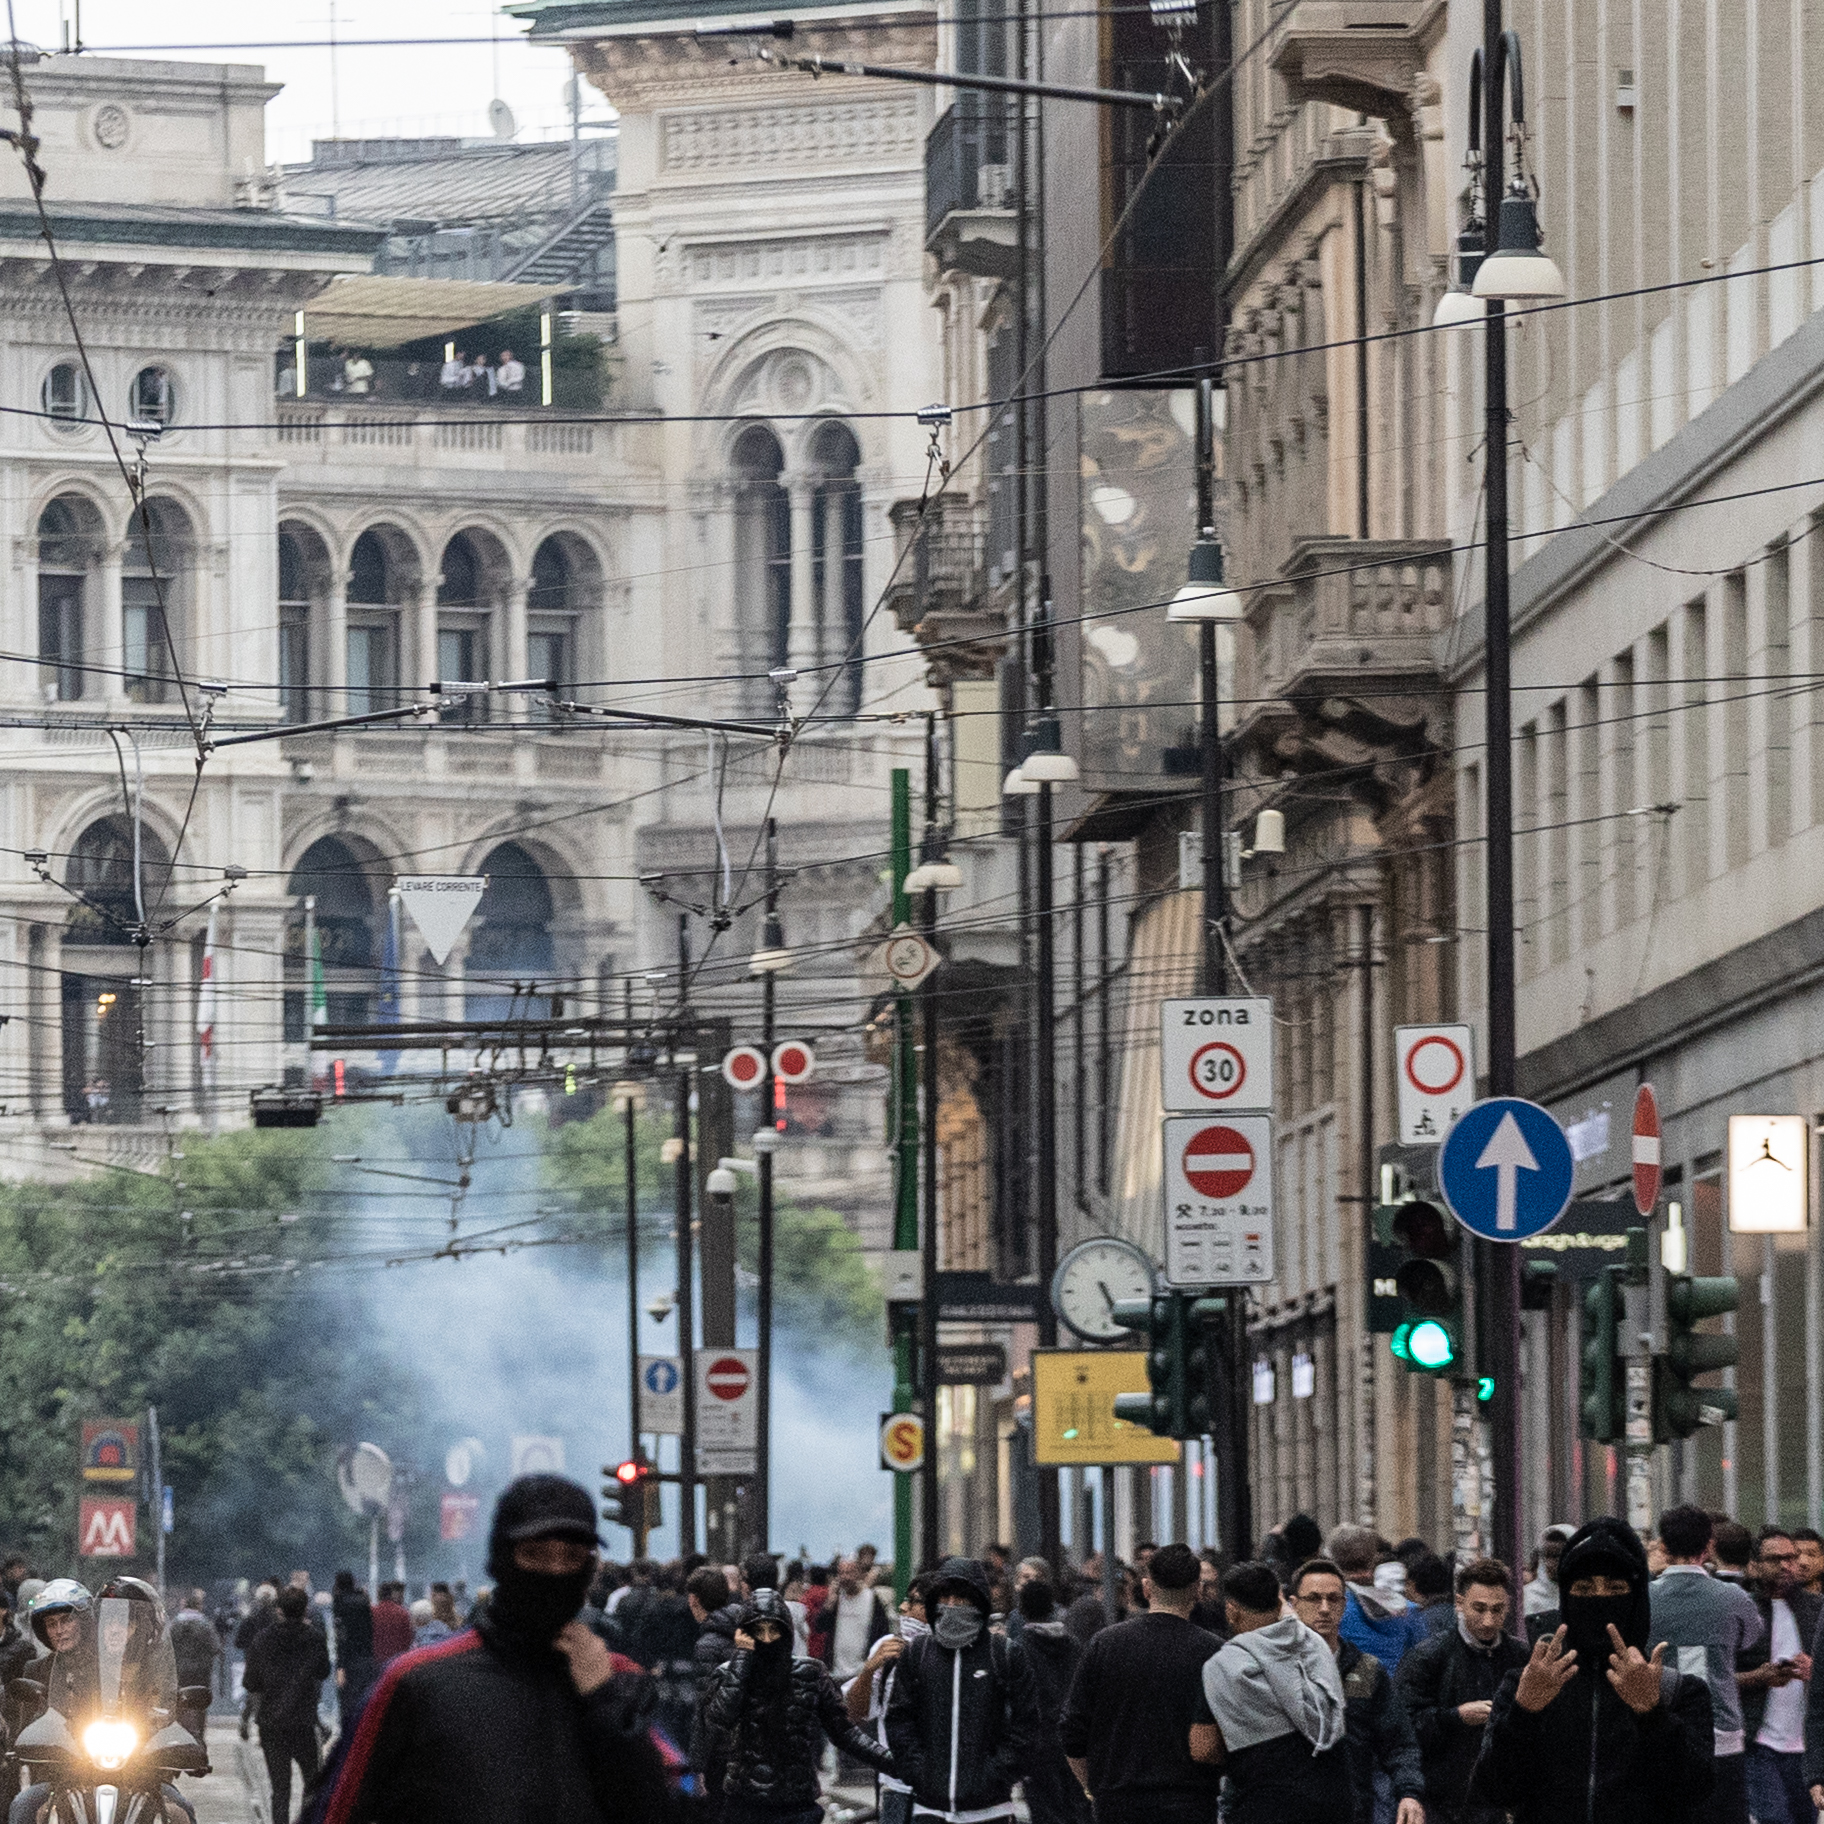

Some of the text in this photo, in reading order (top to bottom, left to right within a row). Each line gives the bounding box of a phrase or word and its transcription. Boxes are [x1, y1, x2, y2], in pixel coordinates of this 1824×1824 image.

[1183, 1008, 1251, 1027] zona
[1203, 1058, 1234, 1083] 30
[84, 1510, 130, 1545] M
